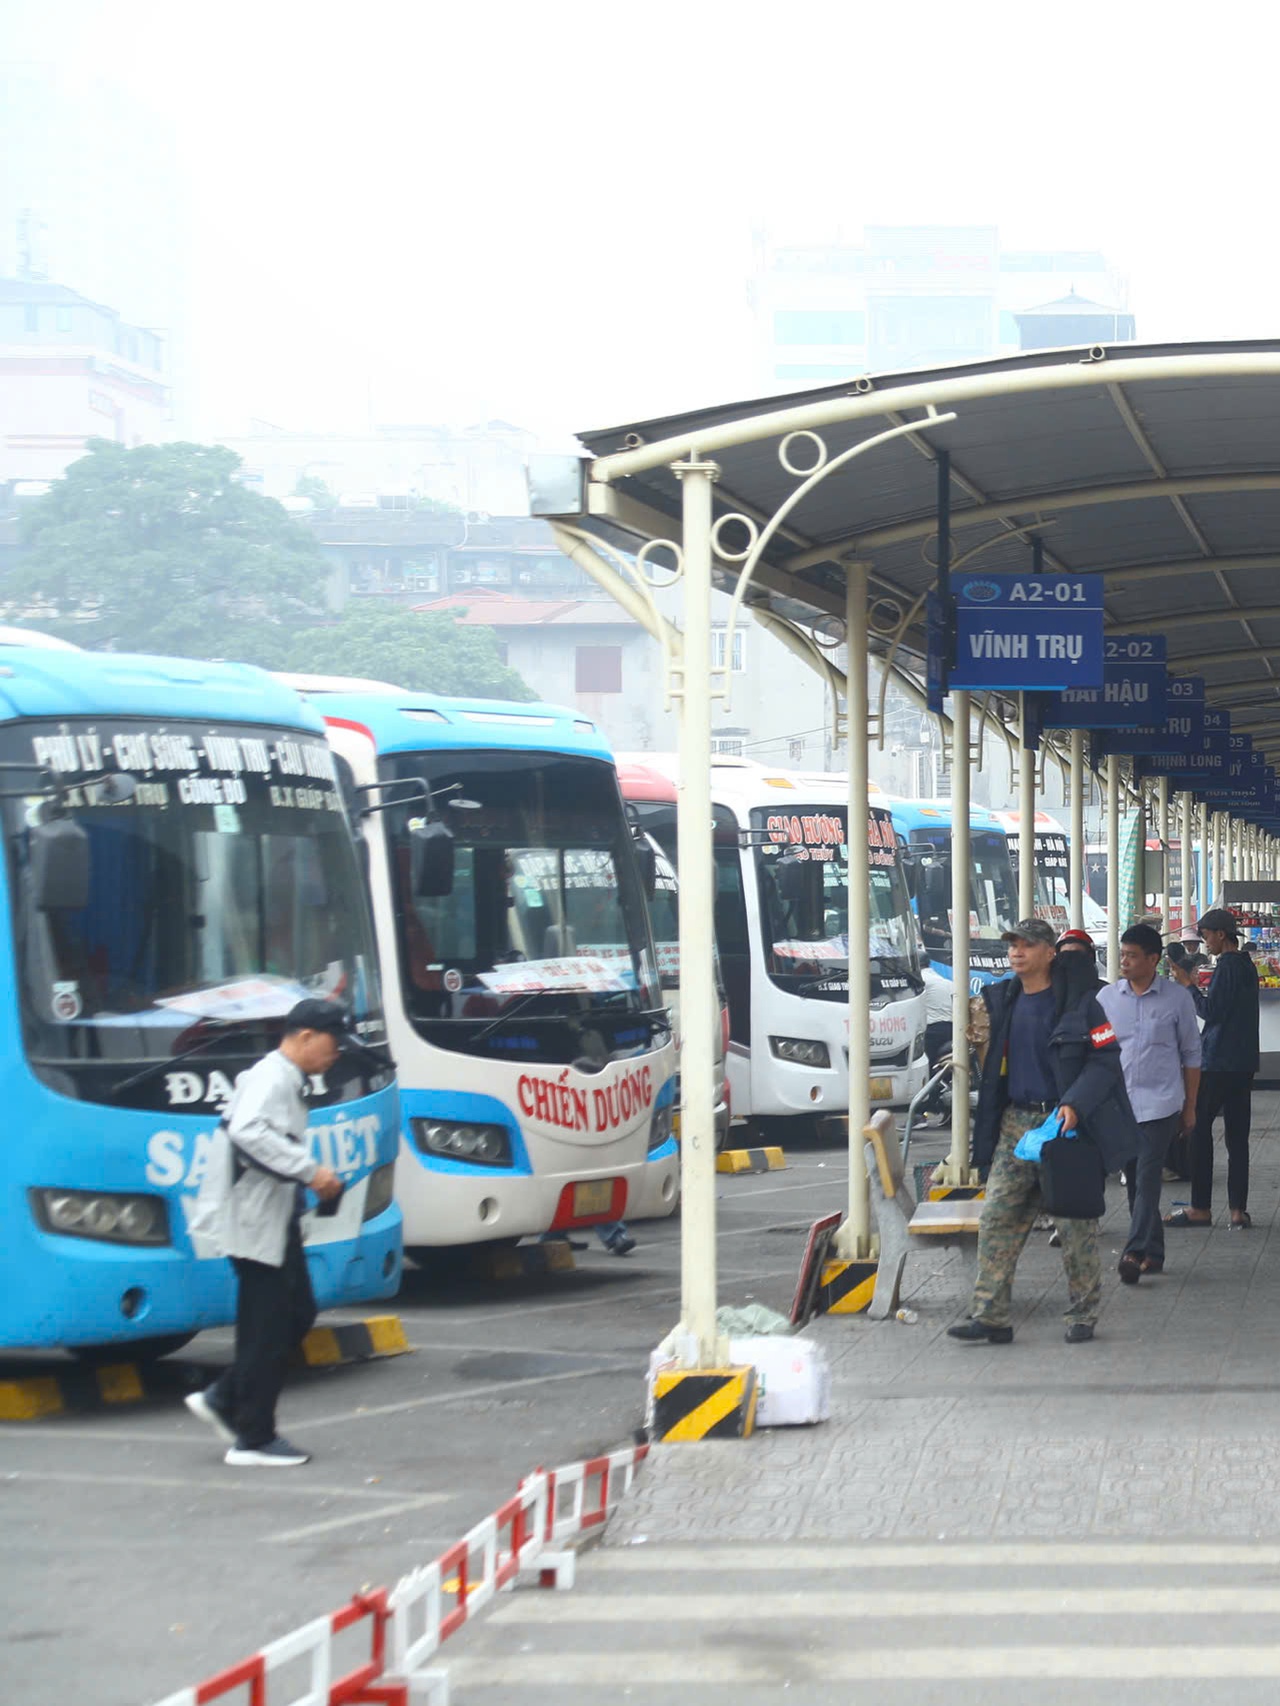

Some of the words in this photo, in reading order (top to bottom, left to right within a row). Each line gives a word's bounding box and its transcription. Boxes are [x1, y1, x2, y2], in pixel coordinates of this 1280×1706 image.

[1009, 582, 1087, 602] A2-01
[969, 629, 1029, 659] VĨNH
[1036, 634, 1083, 664] TRỤ
[1104, 641, 1153, 658] 2-02
[1104, 679, 1149, 706] HẬU
[1190, 755, 1222, 767] LONG
[869, 1037, 894, 1046] SUZU
[517, 1068, 588, 1133] CHIẾN
[593, 1065, 653, 1132] DƯƠNG
